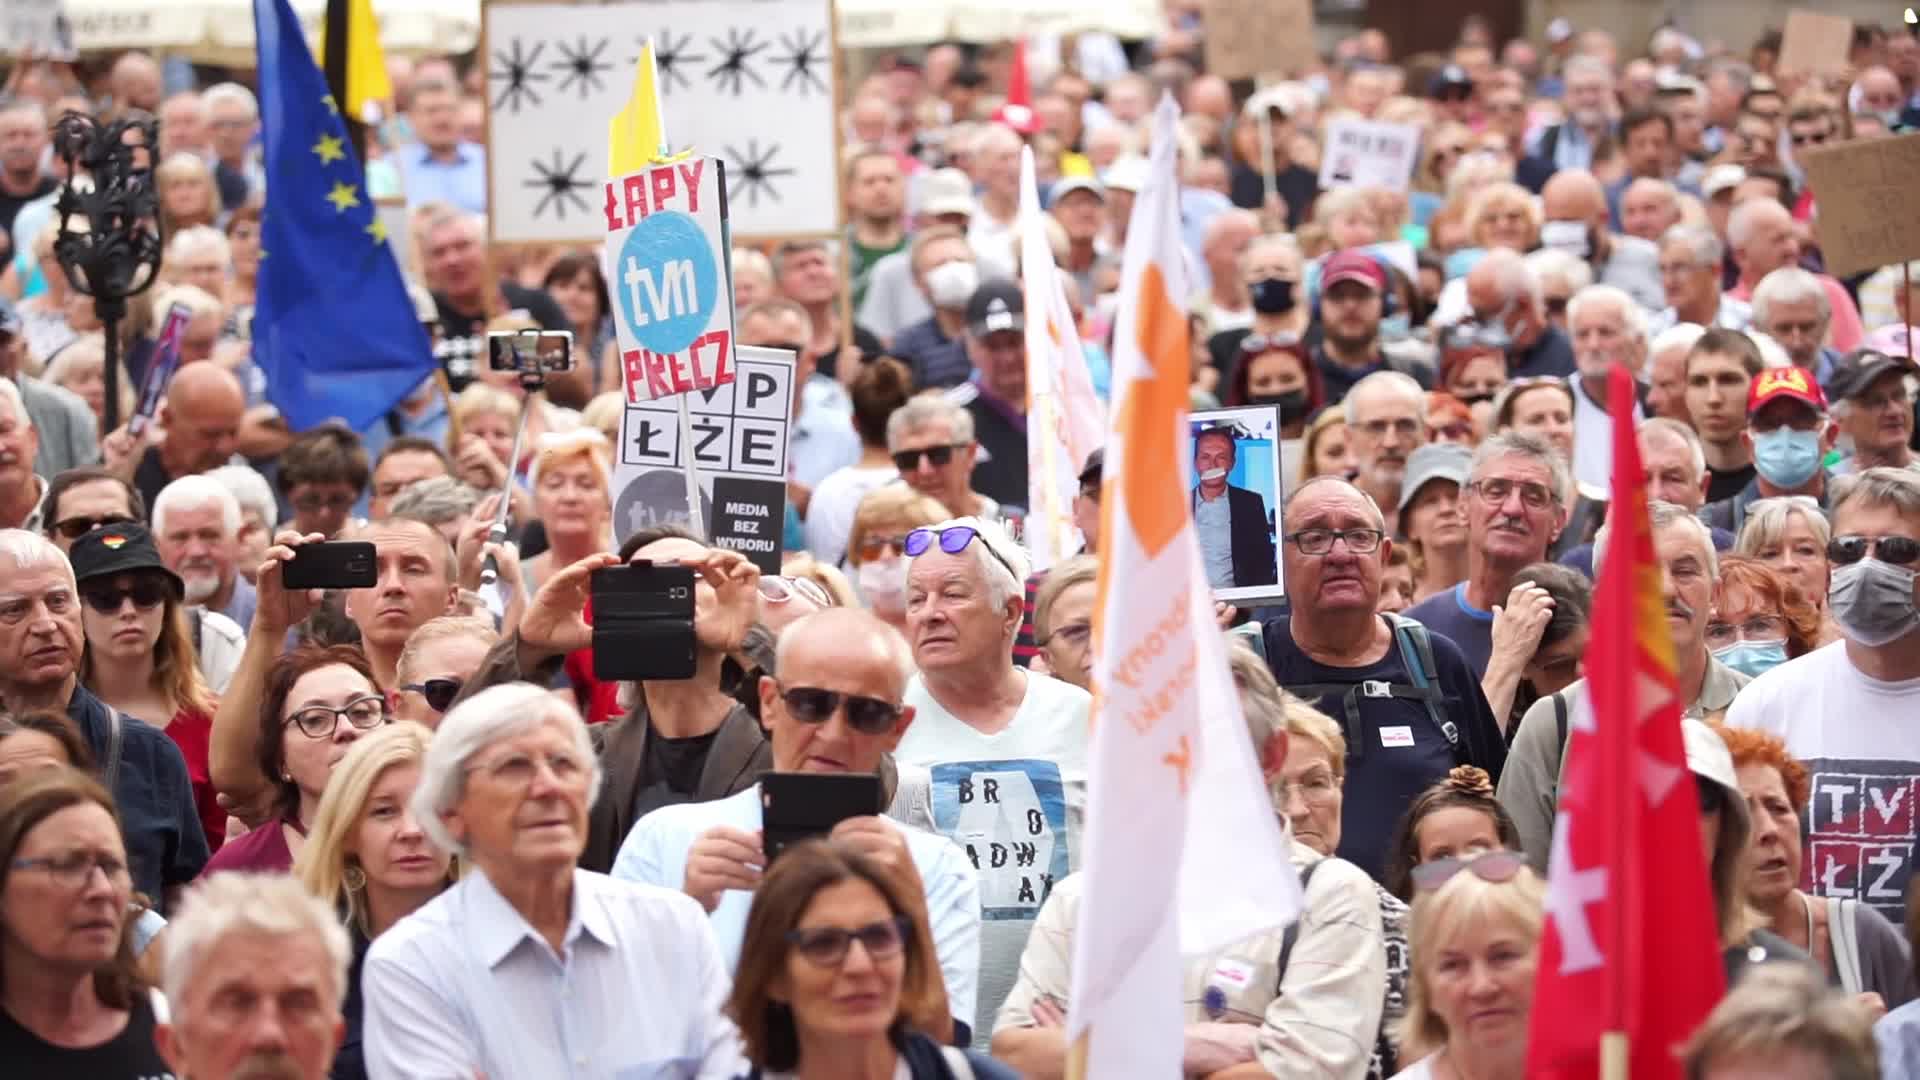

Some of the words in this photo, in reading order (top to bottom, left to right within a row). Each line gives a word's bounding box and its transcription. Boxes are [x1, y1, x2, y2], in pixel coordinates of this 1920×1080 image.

[604, 160, 704, 231] ŁAPY
[625, 256, 699, 327] tvn
[623, 330, 736, 403] PRECZ
[633, 417, 777, 466] ŁŻE
[725, 502, 769, 518] MEDIA
[733, 520, 759, 534] BEZ
[716, 536, 775, 552] WYBORU
[1820, 784, 1908, 825] TV
